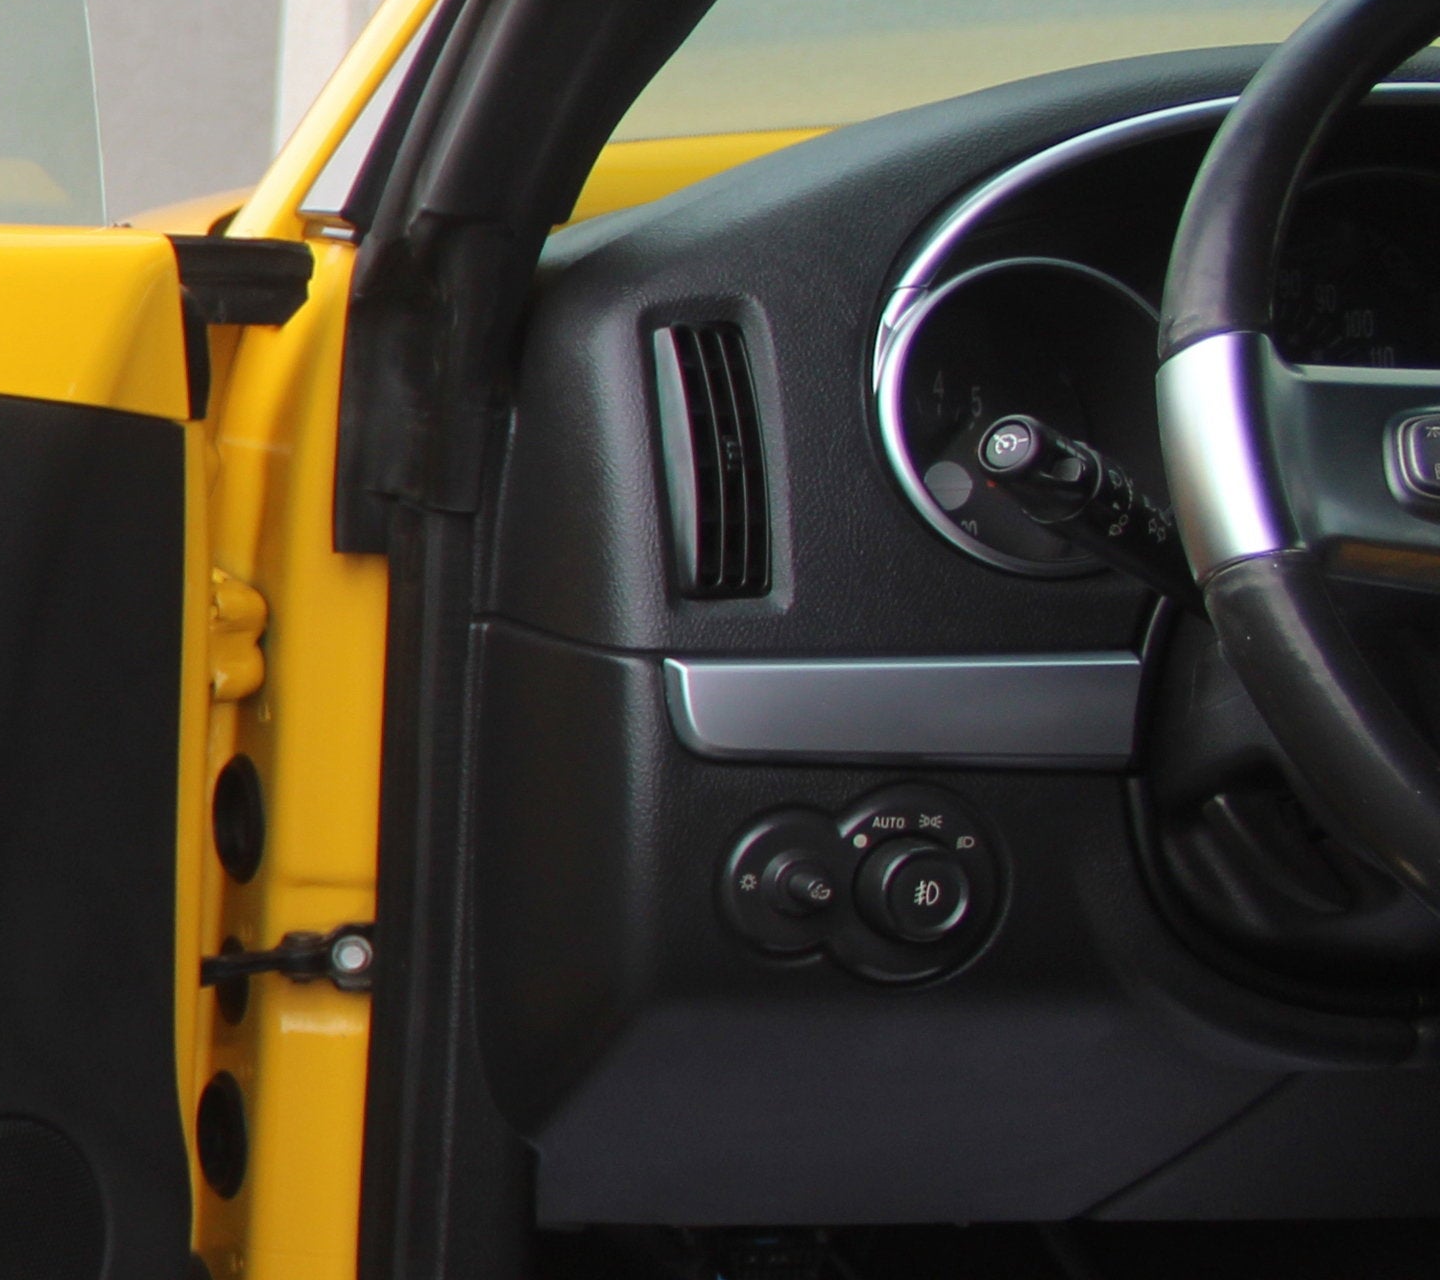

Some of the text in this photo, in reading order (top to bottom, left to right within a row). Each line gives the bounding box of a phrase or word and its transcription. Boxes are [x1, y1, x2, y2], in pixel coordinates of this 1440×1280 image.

[1343, 309, 1375, 338] 100
[932, 370, 945, 399] 4
[970, 385, 983, 418] 5
[872, 816, 905, 829] AUTO
